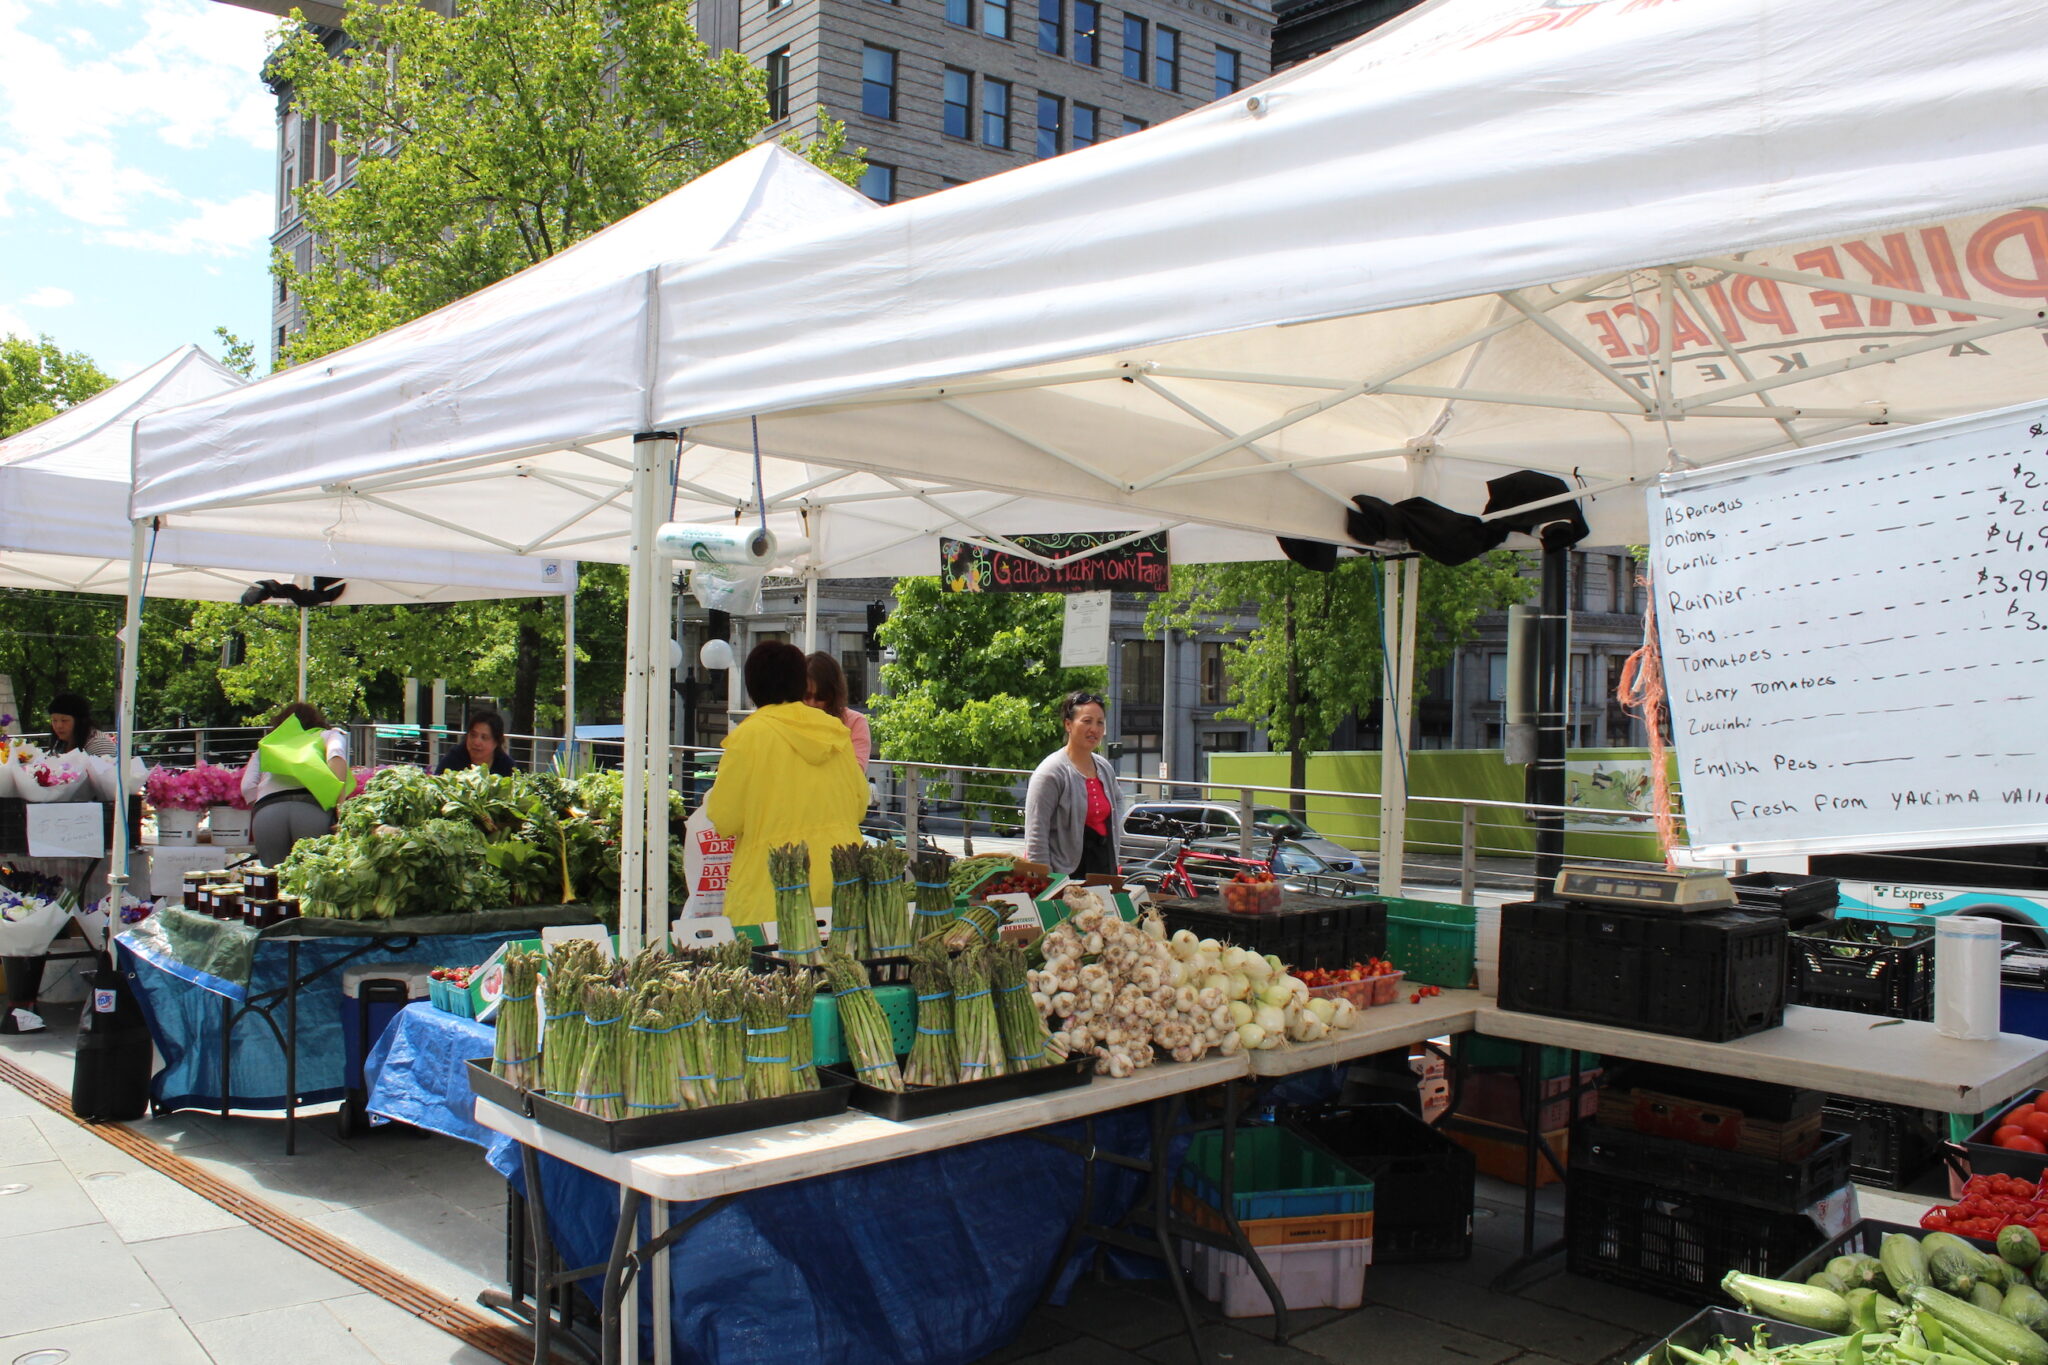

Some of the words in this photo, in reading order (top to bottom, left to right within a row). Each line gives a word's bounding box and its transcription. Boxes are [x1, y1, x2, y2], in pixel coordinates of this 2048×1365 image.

[1668, 586, 1746, 614] Rainier
[1676, 628, 1716, 645] Bing
[1676, 649, 1772, 672] Tomatoes
[1694, 758, 1760, 777] English
[1773, 754, 1818, 771] Peas
[1731, 799, 1799, 820] Fresh
[1893, 886, 1944, 901] Express
